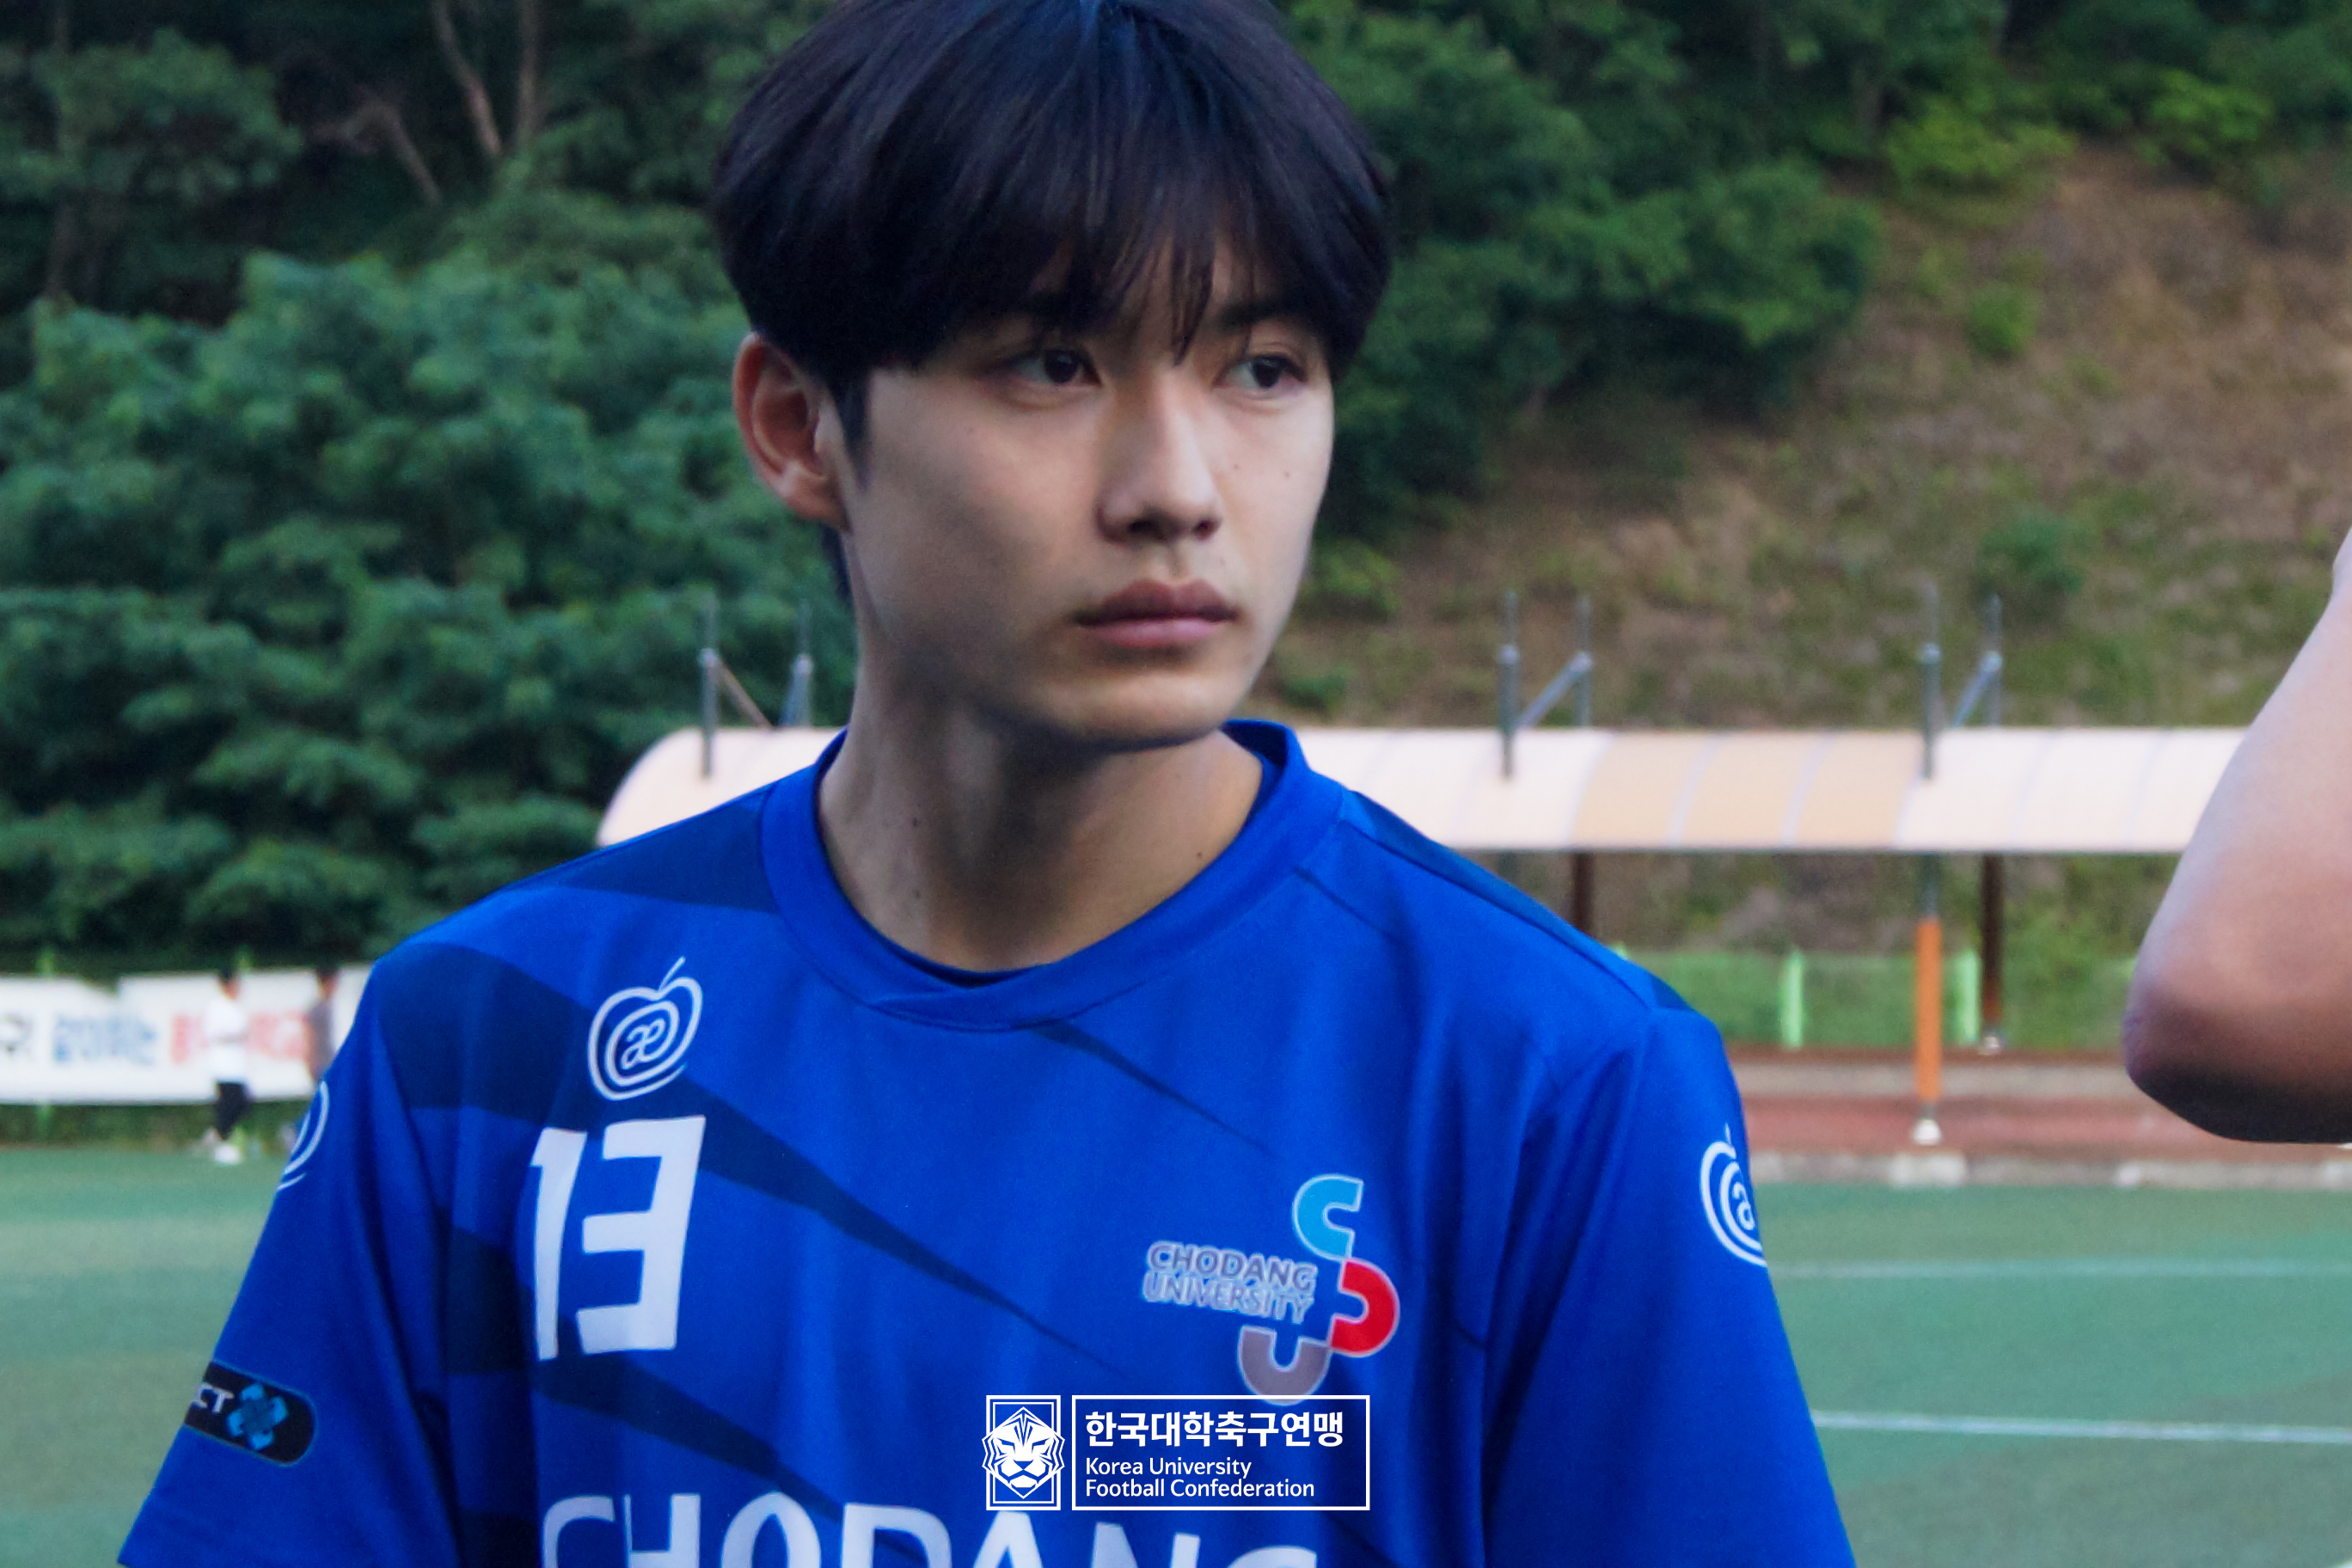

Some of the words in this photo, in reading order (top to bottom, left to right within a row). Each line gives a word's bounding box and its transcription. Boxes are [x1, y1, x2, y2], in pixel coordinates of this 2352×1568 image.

[530, 1115, 706, 1362] 13
[1147, 1240, 1319, 1292] CHODANG
[1142, 1271, 1315, 1325] UNIVERSITY
[542, 1491, 1319, 1568] CHOD
